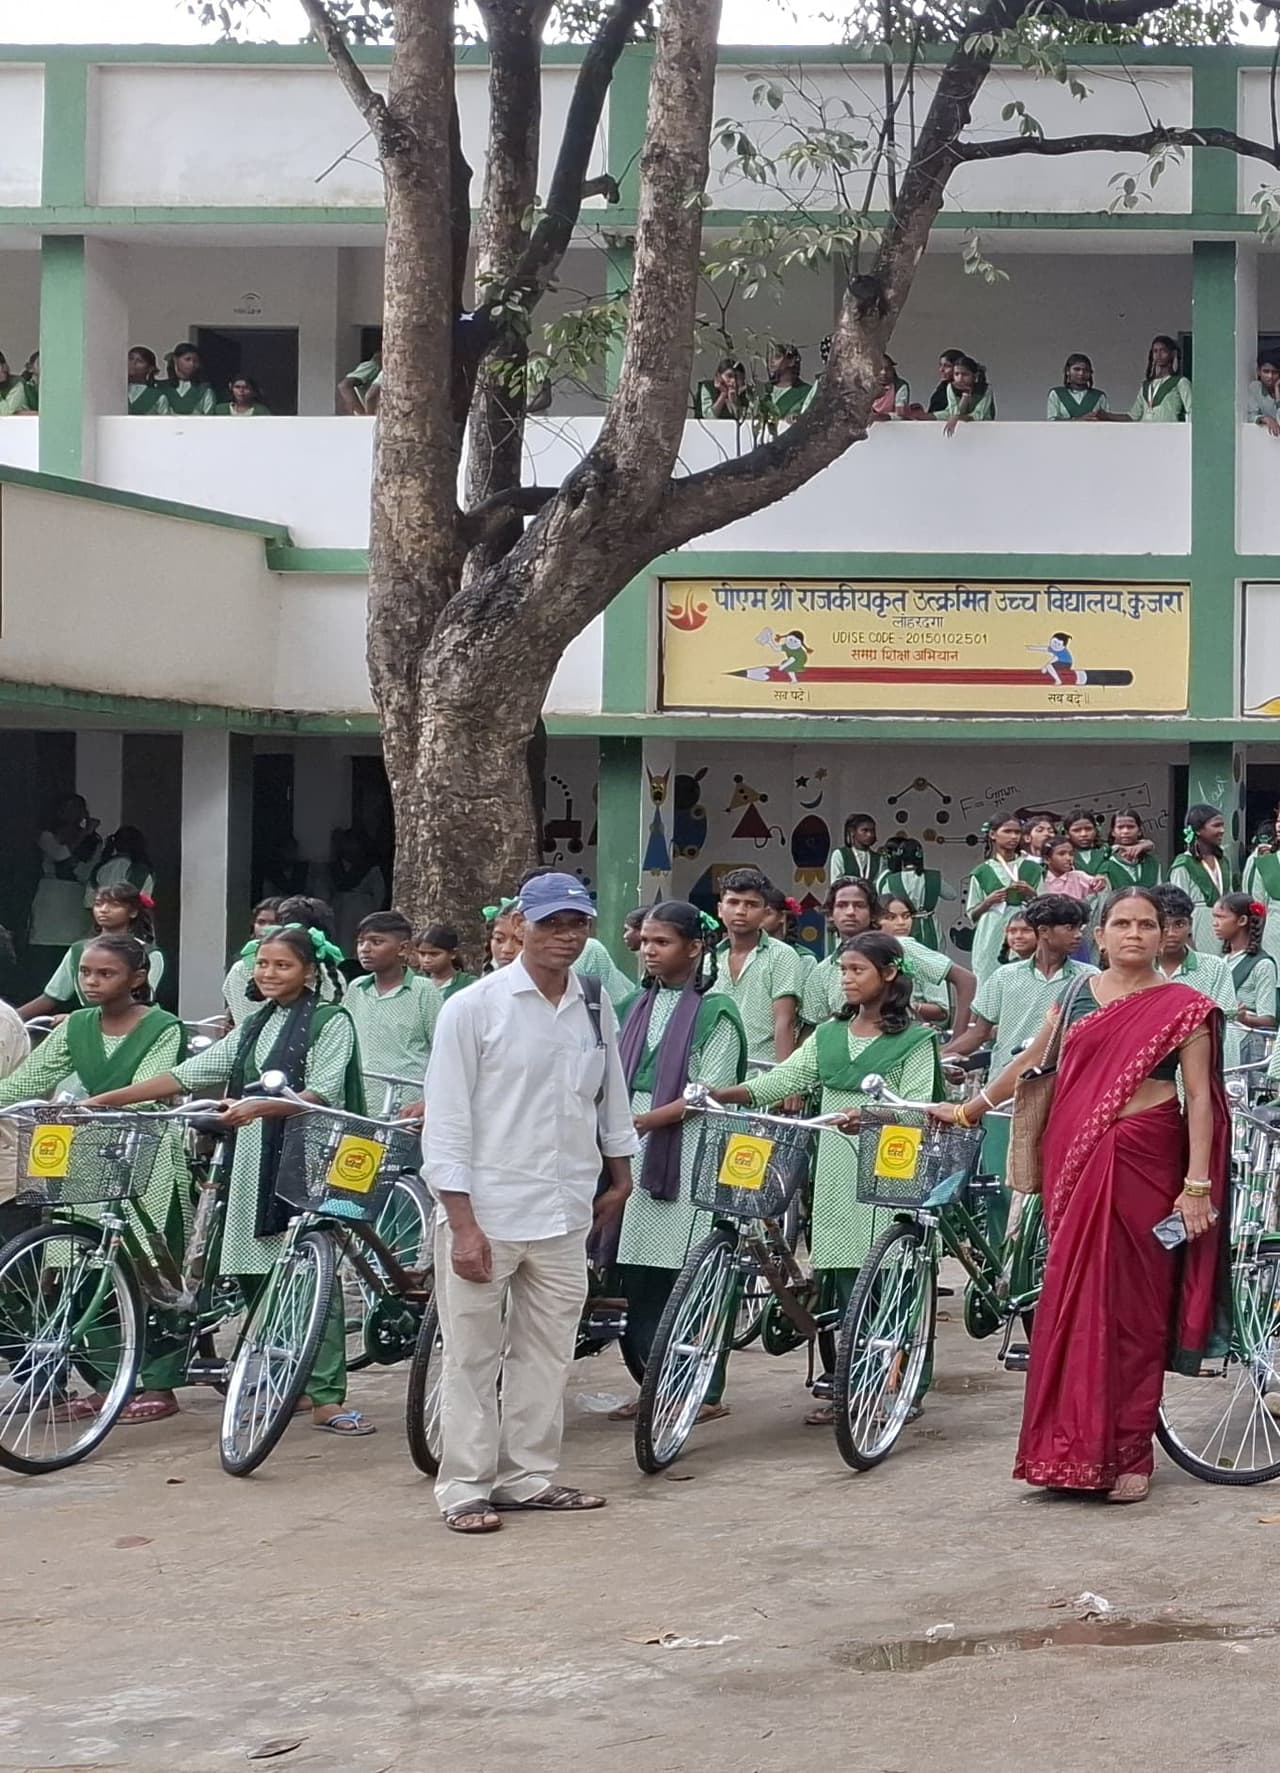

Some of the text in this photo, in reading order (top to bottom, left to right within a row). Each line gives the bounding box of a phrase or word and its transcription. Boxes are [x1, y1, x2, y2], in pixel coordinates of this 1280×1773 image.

[712, 582, 768, 611] पीएम
[771, 582, 793, 611] श्री
[796, 583, 909, 618] राजकीयकृत
[912, 585, 992, 612] उत्क्रमित
[995, 590, 1041, 612] उच्च
[832, 631, 865, 644] UDISE
[868, 631, 895, 644] CODE
[905, 632, 988, 645] 20150102501
[912, 648, 959, 662] अभियान
